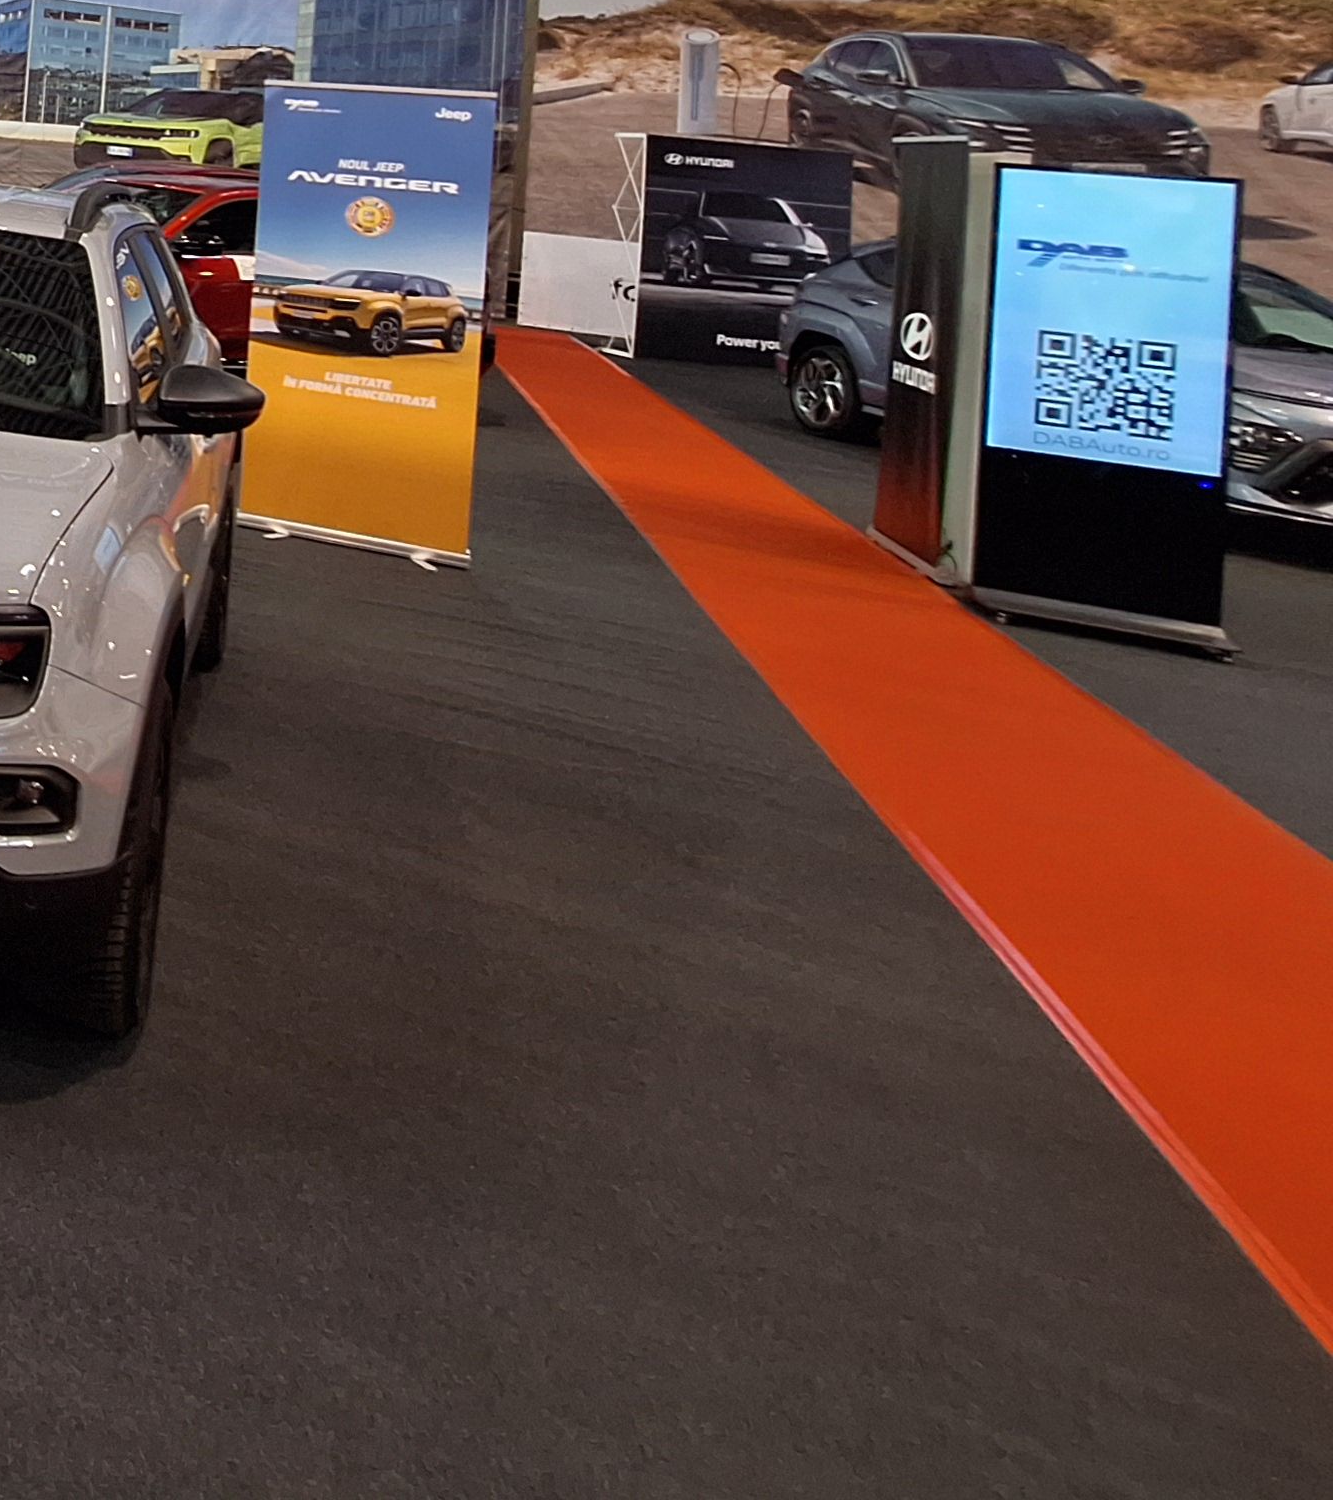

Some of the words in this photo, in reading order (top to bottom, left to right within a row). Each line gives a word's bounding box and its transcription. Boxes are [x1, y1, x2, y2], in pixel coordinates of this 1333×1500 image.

[435, 107, 472, 122] Jeep
[338, 159, 370, 172] NOUL
[373, 161, 406, 173] JEEP
[287, 169, 460, 195] AVENGER
[1017, 238, 1129, 258] DAB
[716, 334, 758, 349] Power
[324, 371, 393, 391] LIBERTATE
[892, 360, 936, 395] HYUNDA
[1033, 431, 1171, 461] DABAuto.ro
